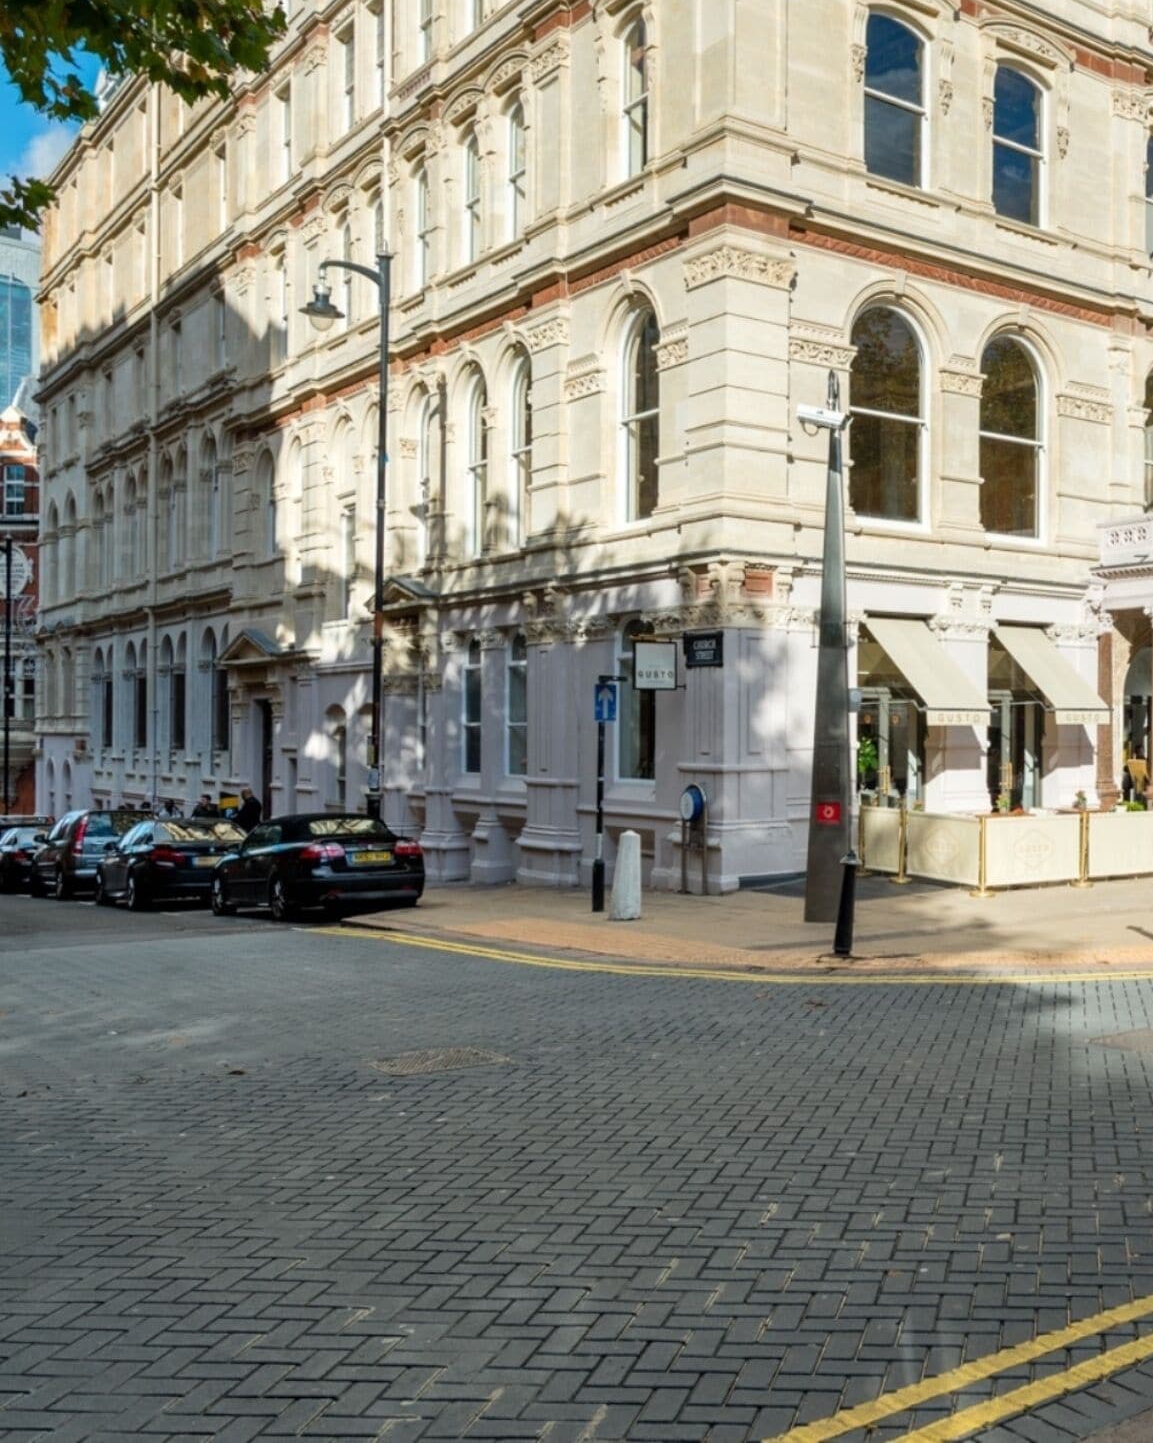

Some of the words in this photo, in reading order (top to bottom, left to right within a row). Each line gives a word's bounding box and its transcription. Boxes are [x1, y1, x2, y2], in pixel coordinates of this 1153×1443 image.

[637, 669, 674, 679] GUSTO
[937, 713, 981, 723] GUSTO
[1065, 713, 1101, 722] GUSTO
